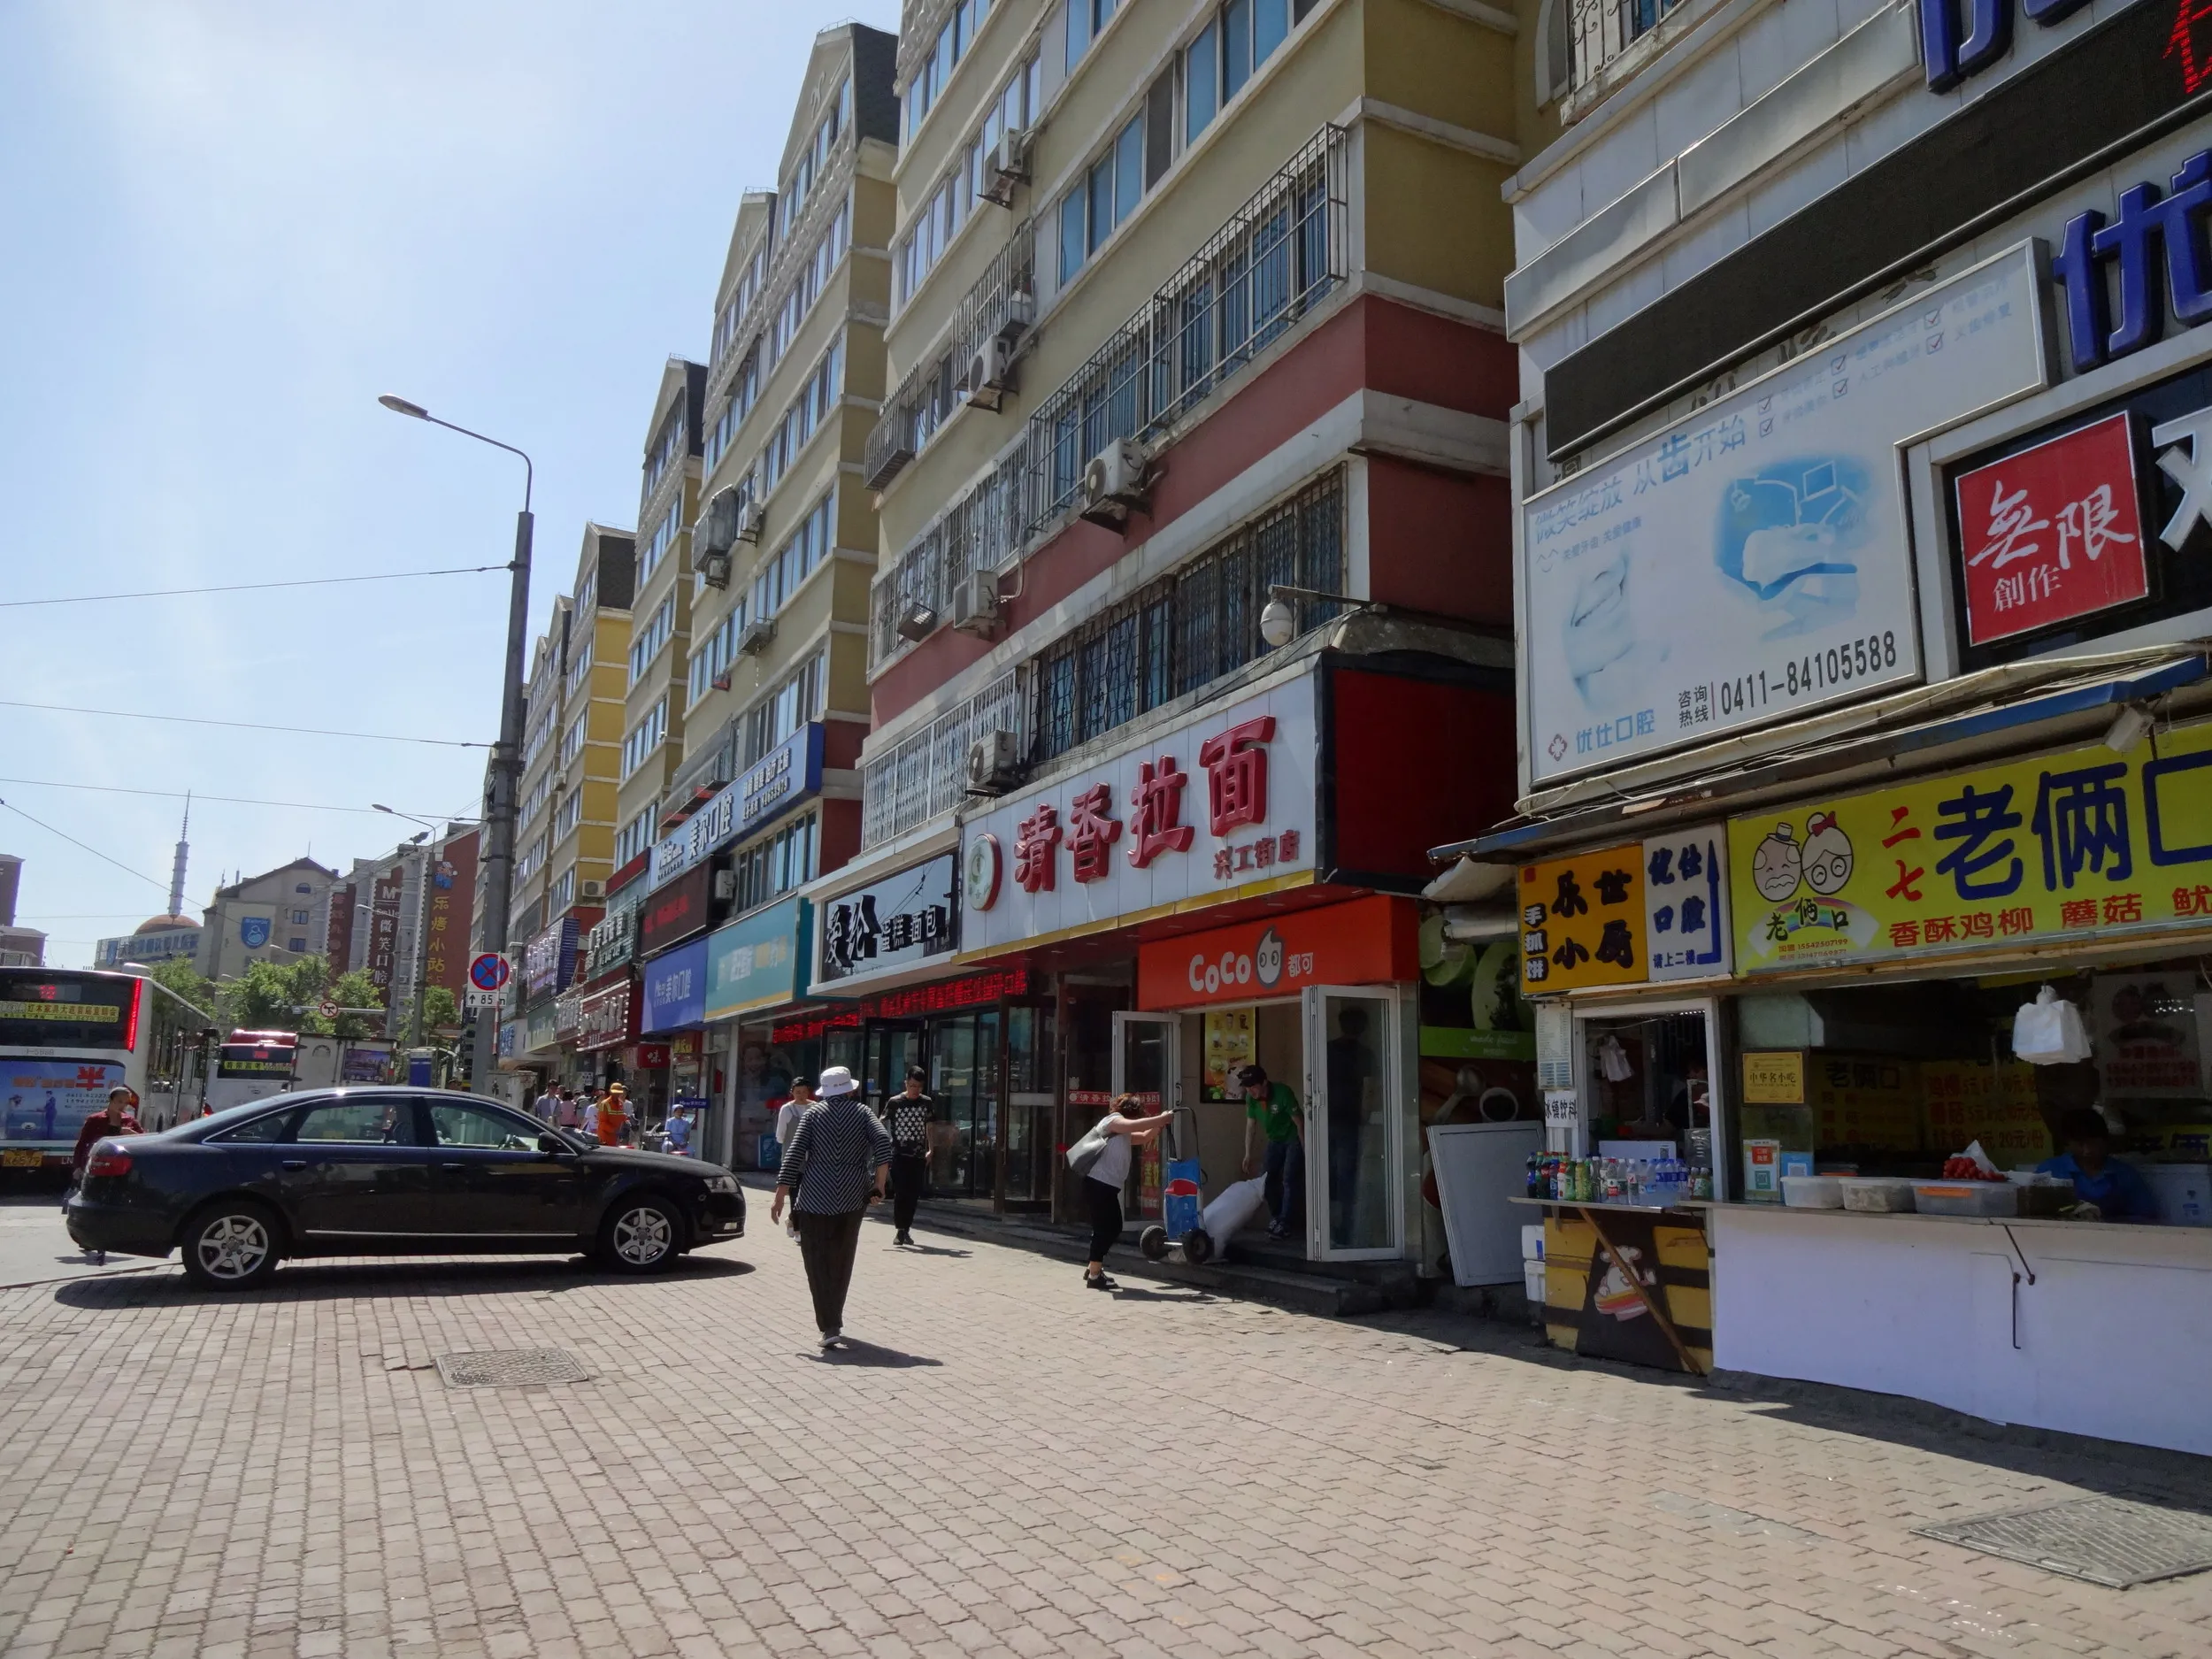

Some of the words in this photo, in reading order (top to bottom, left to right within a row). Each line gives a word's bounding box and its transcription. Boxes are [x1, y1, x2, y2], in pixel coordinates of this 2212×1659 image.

[1632, 414, 1746, 495] 从齿开始
[1968, 479, 2136, 571] 無限
[1993, 564, 2062, 612] 創作
[1678, 704, 1709, 728] 热线
[1721, 630, 1897, 715] 0411-84105588
[1678, 685, 1708, 710] 咨询
[1576, 709, 1655, 755] 优仕口腔
[687, 793, 734, 860] 美尔口腔
[1014, 715, 1276, 894] 清香拉面
[1882, 806, 1922, 902] 二七
[1932, 749, 2212, 902] 老俩口
[881, 905, 941, 953] 蛋糕面包
[1523, 902, 1549, 983] 手抓饼
[1765, 896, 1849, 941] 老俩口
[1889, 906, 2034, 947] 香酥鸡柳
[2060, 893, 2142, 928] 蘑菇
[373, 919, 393, 984] 微笑口腔
[1188, 951, 1251, 994] CoCo
[1288, 952, 1314, 978] 都可
[1652, 949, 1697, 970] 请上二楼
[480, 995, 493, 1005] 85
[665, 969, 692, 1003] 美尔口腔
